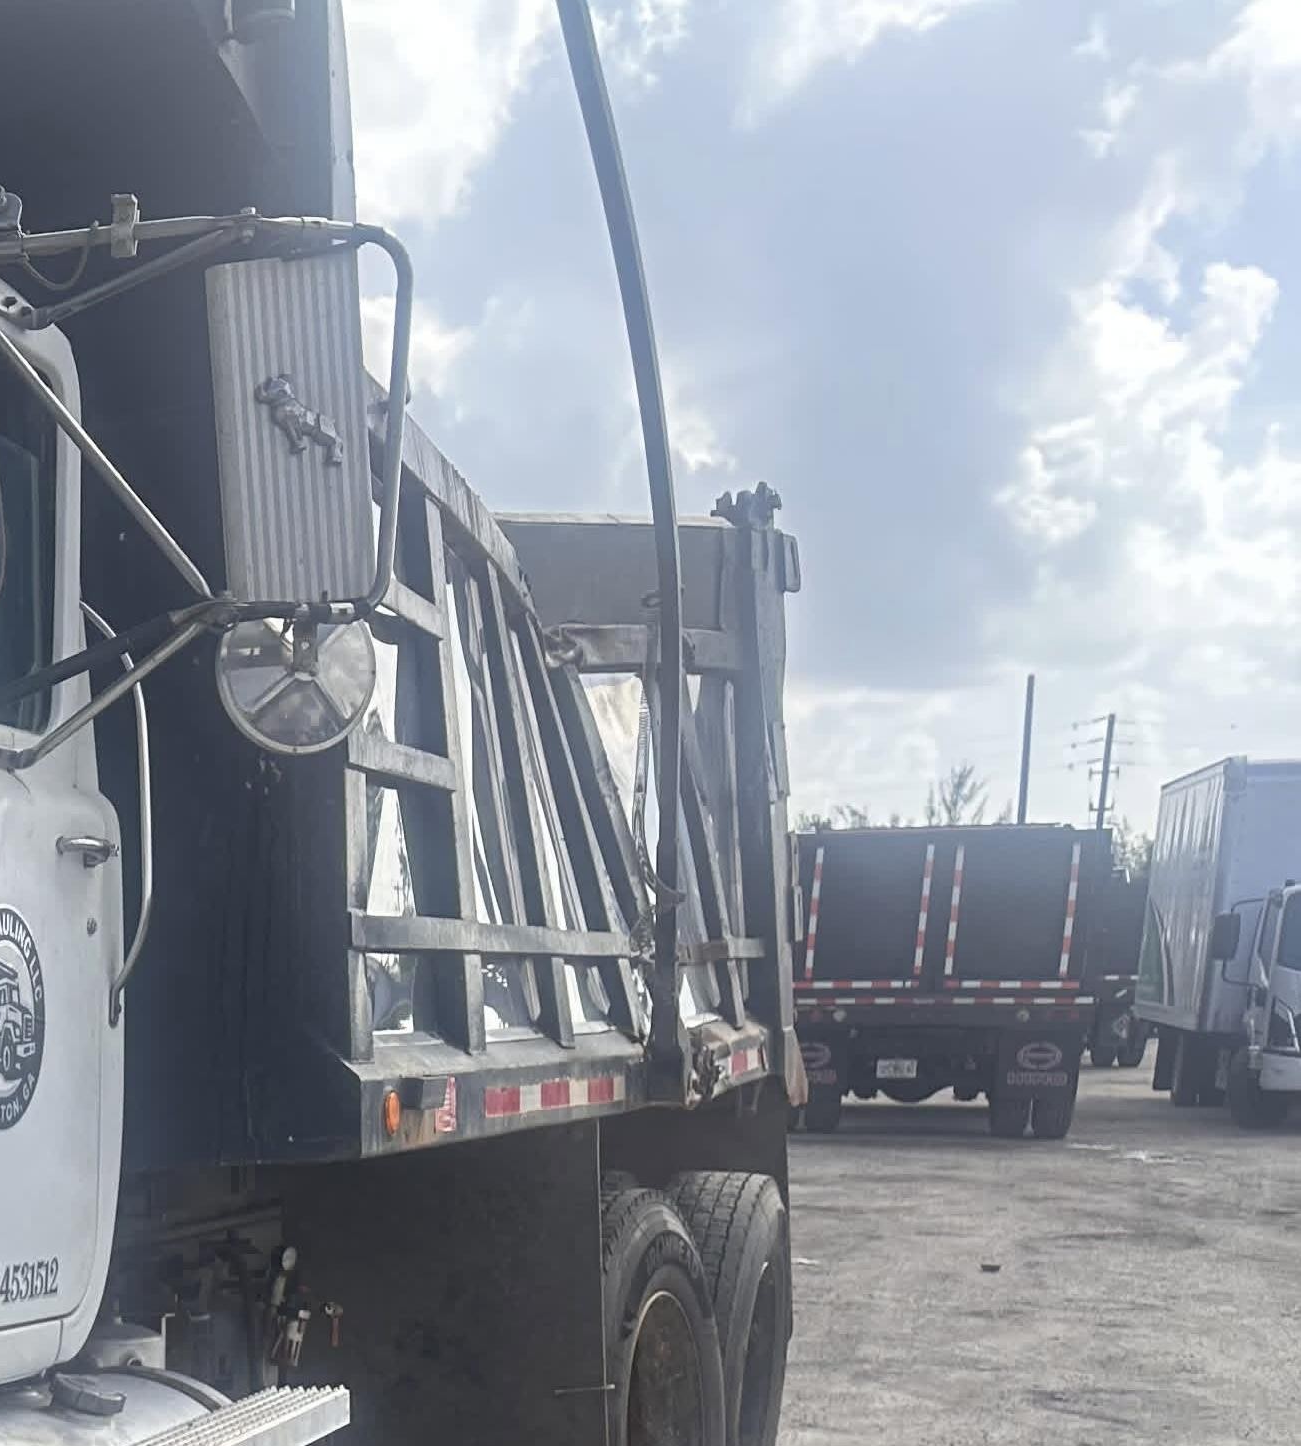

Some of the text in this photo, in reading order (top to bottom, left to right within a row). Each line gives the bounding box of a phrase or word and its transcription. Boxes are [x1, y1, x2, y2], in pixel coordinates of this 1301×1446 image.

[30, 956, 43, 1002] LLC
[23, 1072, 36, 1101] GA
[0, 1256, 59, 1304] 4531512
